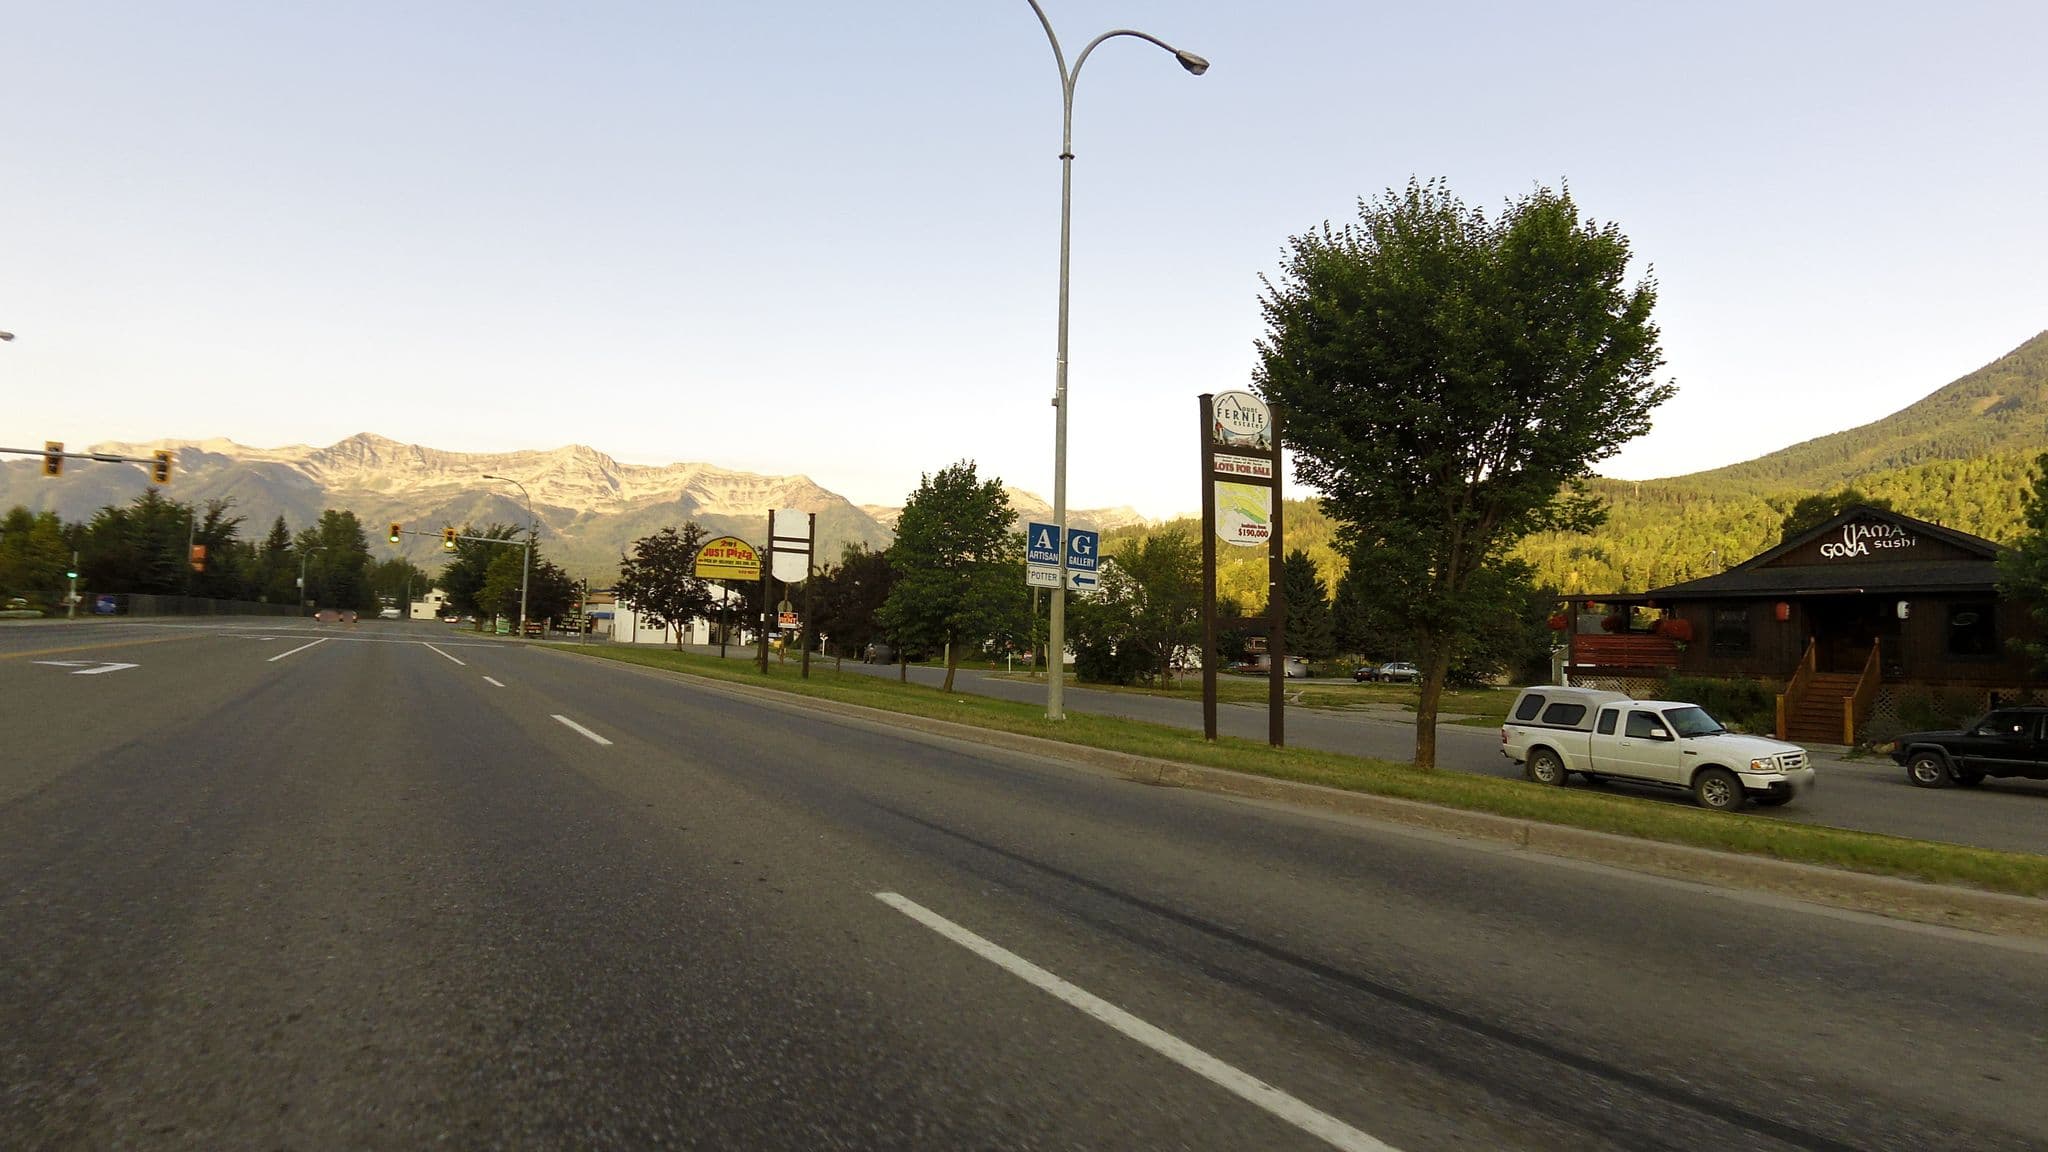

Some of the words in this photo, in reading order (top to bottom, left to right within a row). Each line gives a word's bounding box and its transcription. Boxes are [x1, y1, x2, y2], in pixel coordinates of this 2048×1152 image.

[1217, 408, 1263, 424] FERNIE
[1233, 420, 1263, 430] estates
[1214, 462, 1234, 472] LOTS
[1236, 464, 1251, 474] FOR
[1252, 466, 1271, 476] SALE
[1034, 528, 1053, 550] A
[1238, 528, 1269, 538] $190,000
[1072, 535, 1092, 555] G
[704, 548, 724, 558] JUST
[727, 548, 753, 561] Pizza
[1029, 549, 1059, 562] ARTISAN
[1069, 555, 1095, 568] GALLERY
[1031, 571, 1057, 581] POTTER
